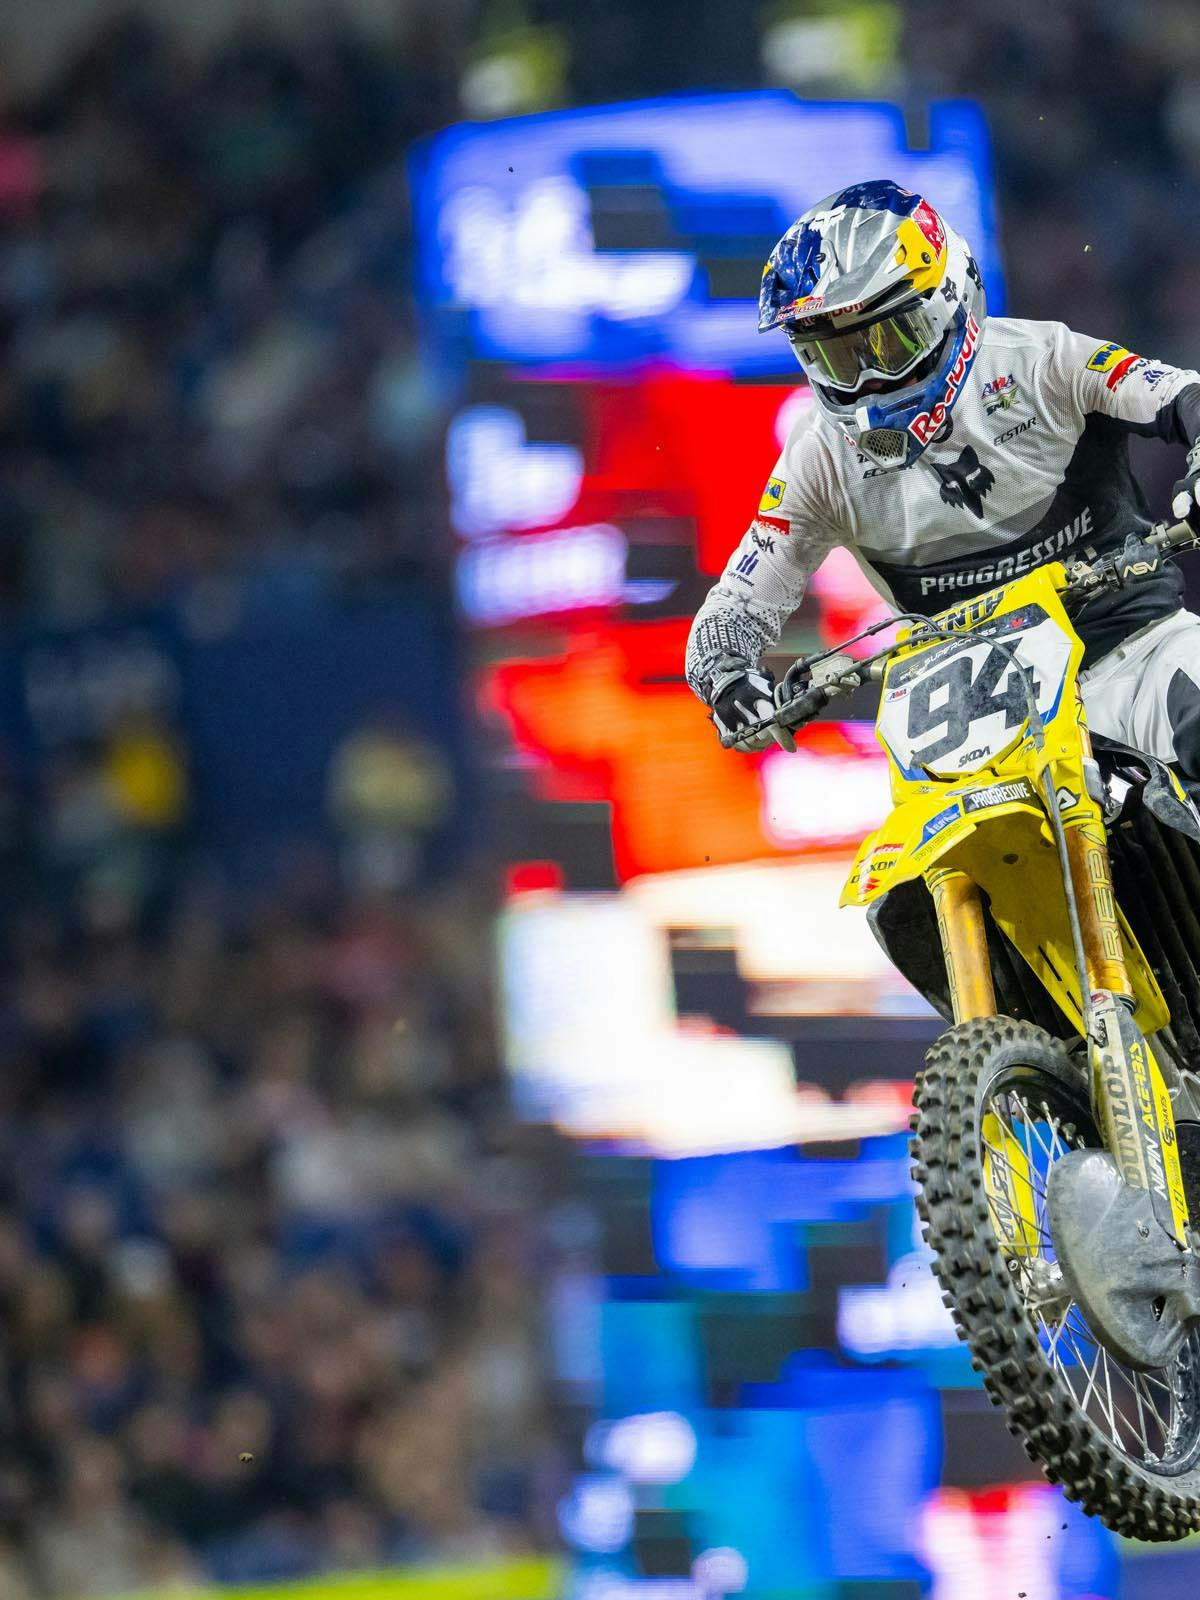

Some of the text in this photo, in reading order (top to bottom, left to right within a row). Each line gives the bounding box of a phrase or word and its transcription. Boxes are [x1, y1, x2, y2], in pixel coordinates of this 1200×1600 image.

[908, 311, 981, 446] Red Bull
[993, 416, 1036, 446] ECSTAR
[920, 506, 1094, 596] PROGRESSIVE
[1123, 558, 1158, 579] ASV
[906, 637, 1042, 771] 94
[957, 745, 991, 768] SKDA
[970, 782, 1031, 809] PROGRESSIVE
[1102, 1054, 1143, 1188] DUNLOP
